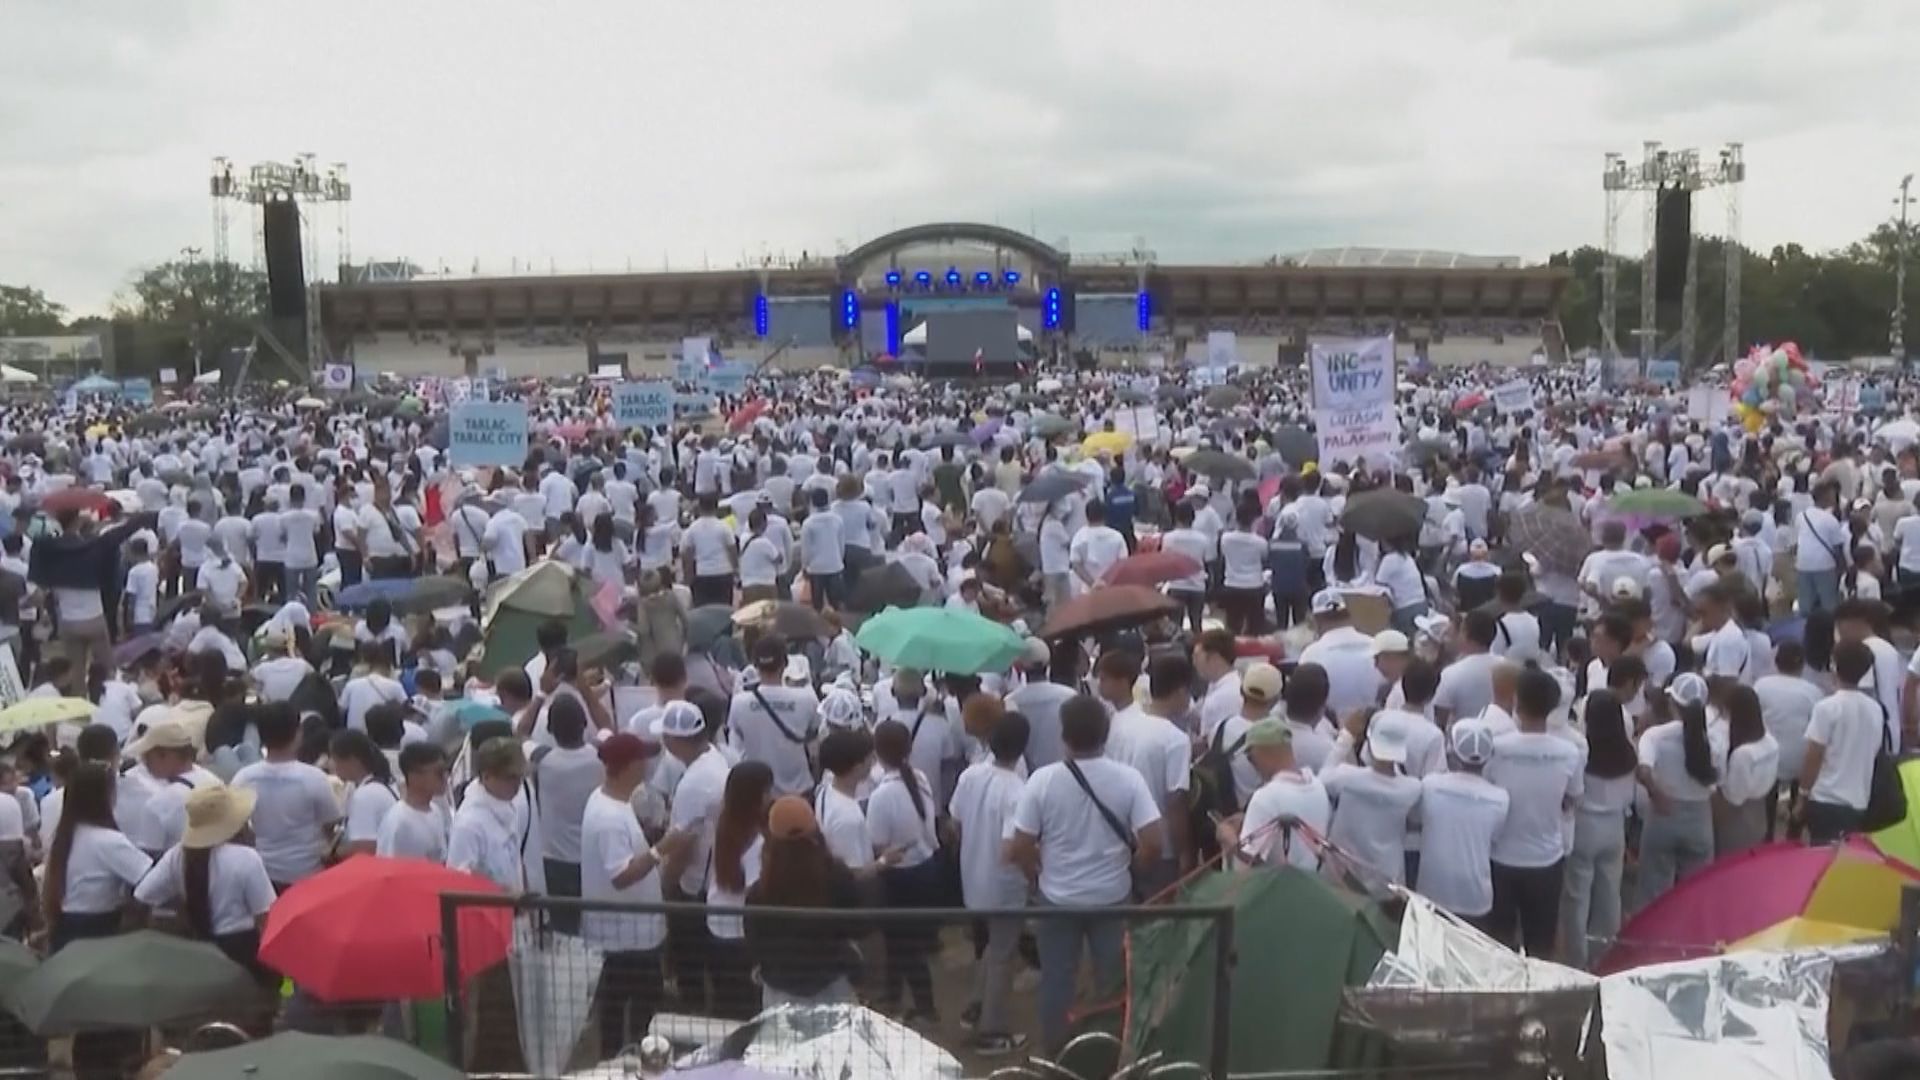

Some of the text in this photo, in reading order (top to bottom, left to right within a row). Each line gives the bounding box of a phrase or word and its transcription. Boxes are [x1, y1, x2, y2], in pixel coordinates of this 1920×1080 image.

[1327, 352, 1359, 373] INC
[1329, 368, 1382, 392] UNITY
[620, 393, 667, 406] TARLAC-
[620, 406, 668, 419] PANIQUI
[465, 418, 510, 430] TARLAC-
[453, 432, 523, 445] TARLAC CITY
